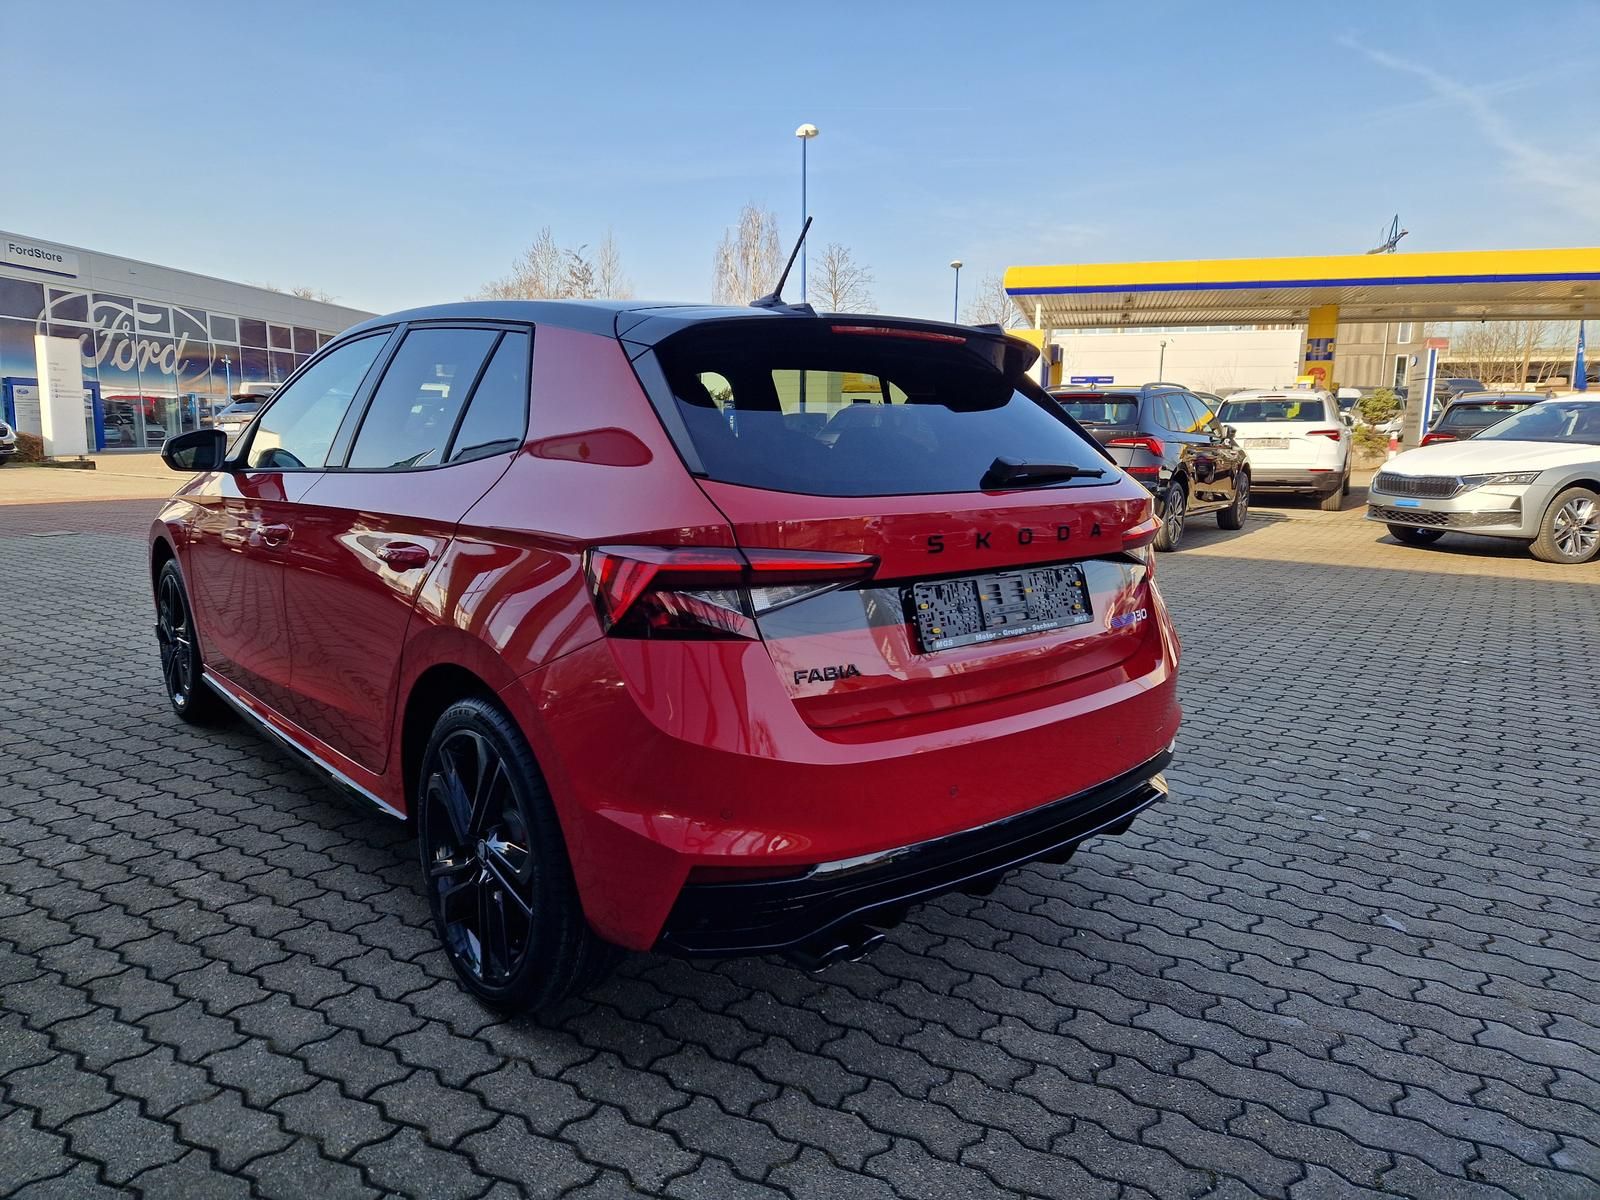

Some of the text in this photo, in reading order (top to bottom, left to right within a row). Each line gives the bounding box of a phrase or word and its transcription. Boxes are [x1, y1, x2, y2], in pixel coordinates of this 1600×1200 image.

[8, 243, 63, 263] FordStore
[79, 300, 190, 375] Ford
[935, 639, 954, 649] MGS
[975, 631, 997, 642] Motor
[1002, 627, 1027, 638] Gruppe
[1032, 620, 1058, 631] Sachsen
[793, 663, 861, 685] FABIA
